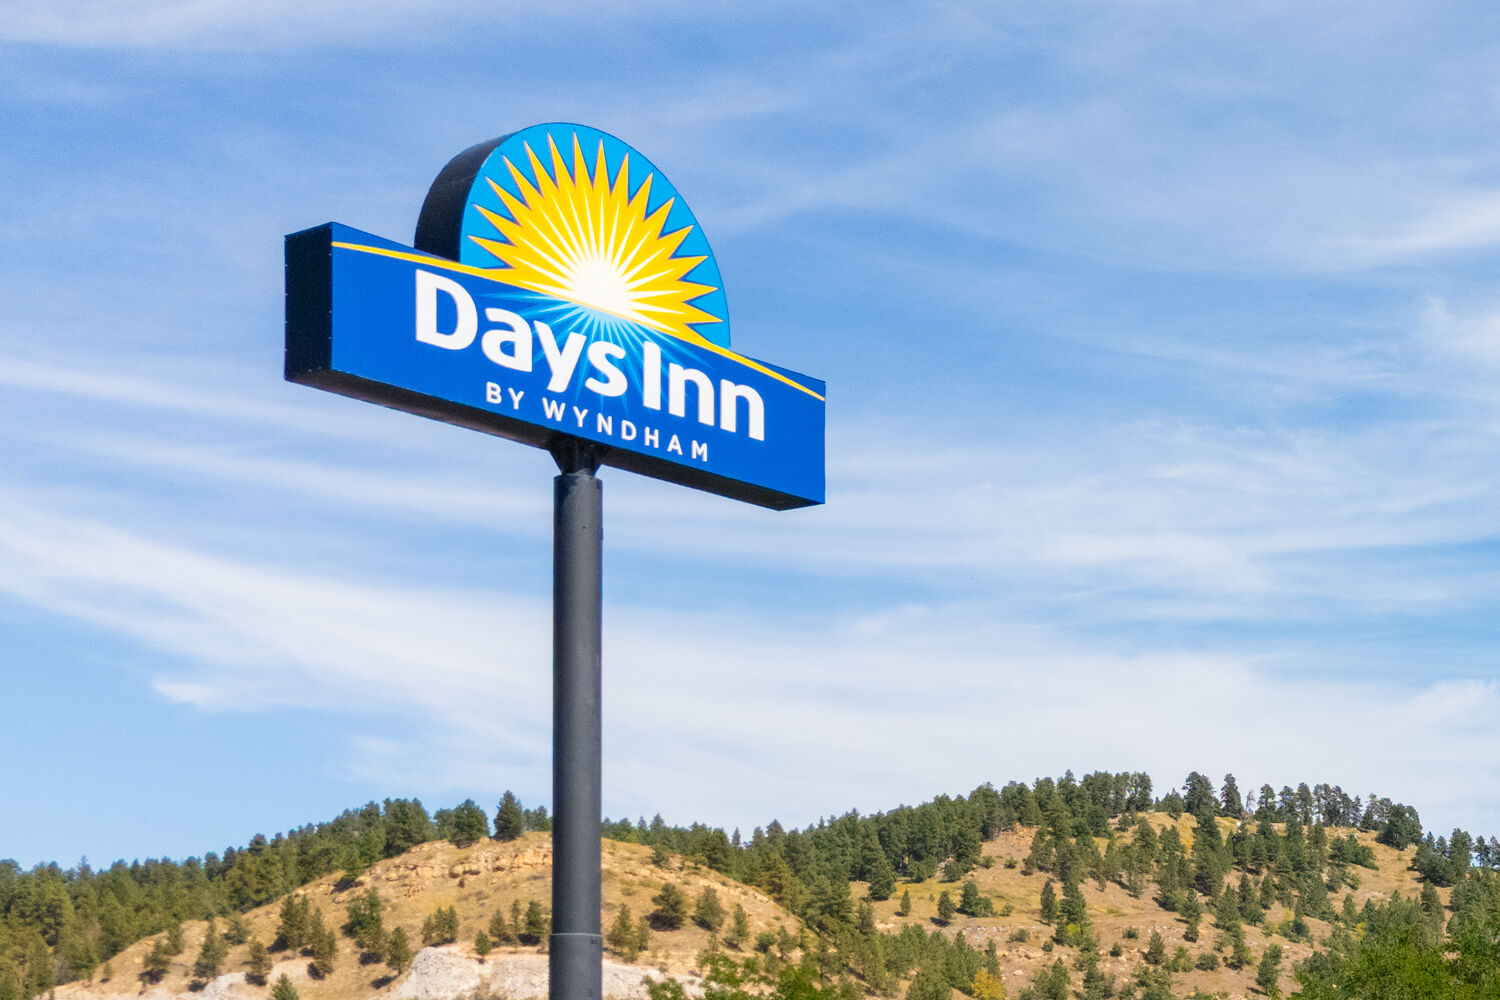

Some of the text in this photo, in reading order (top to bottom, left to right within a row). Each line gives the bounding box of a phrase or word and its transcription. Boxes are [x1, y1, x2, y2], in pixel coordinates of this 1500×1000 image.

[415, 269, 765, 442] Days Inn
[486, 381, 708, 462] BY WYNDHAM
